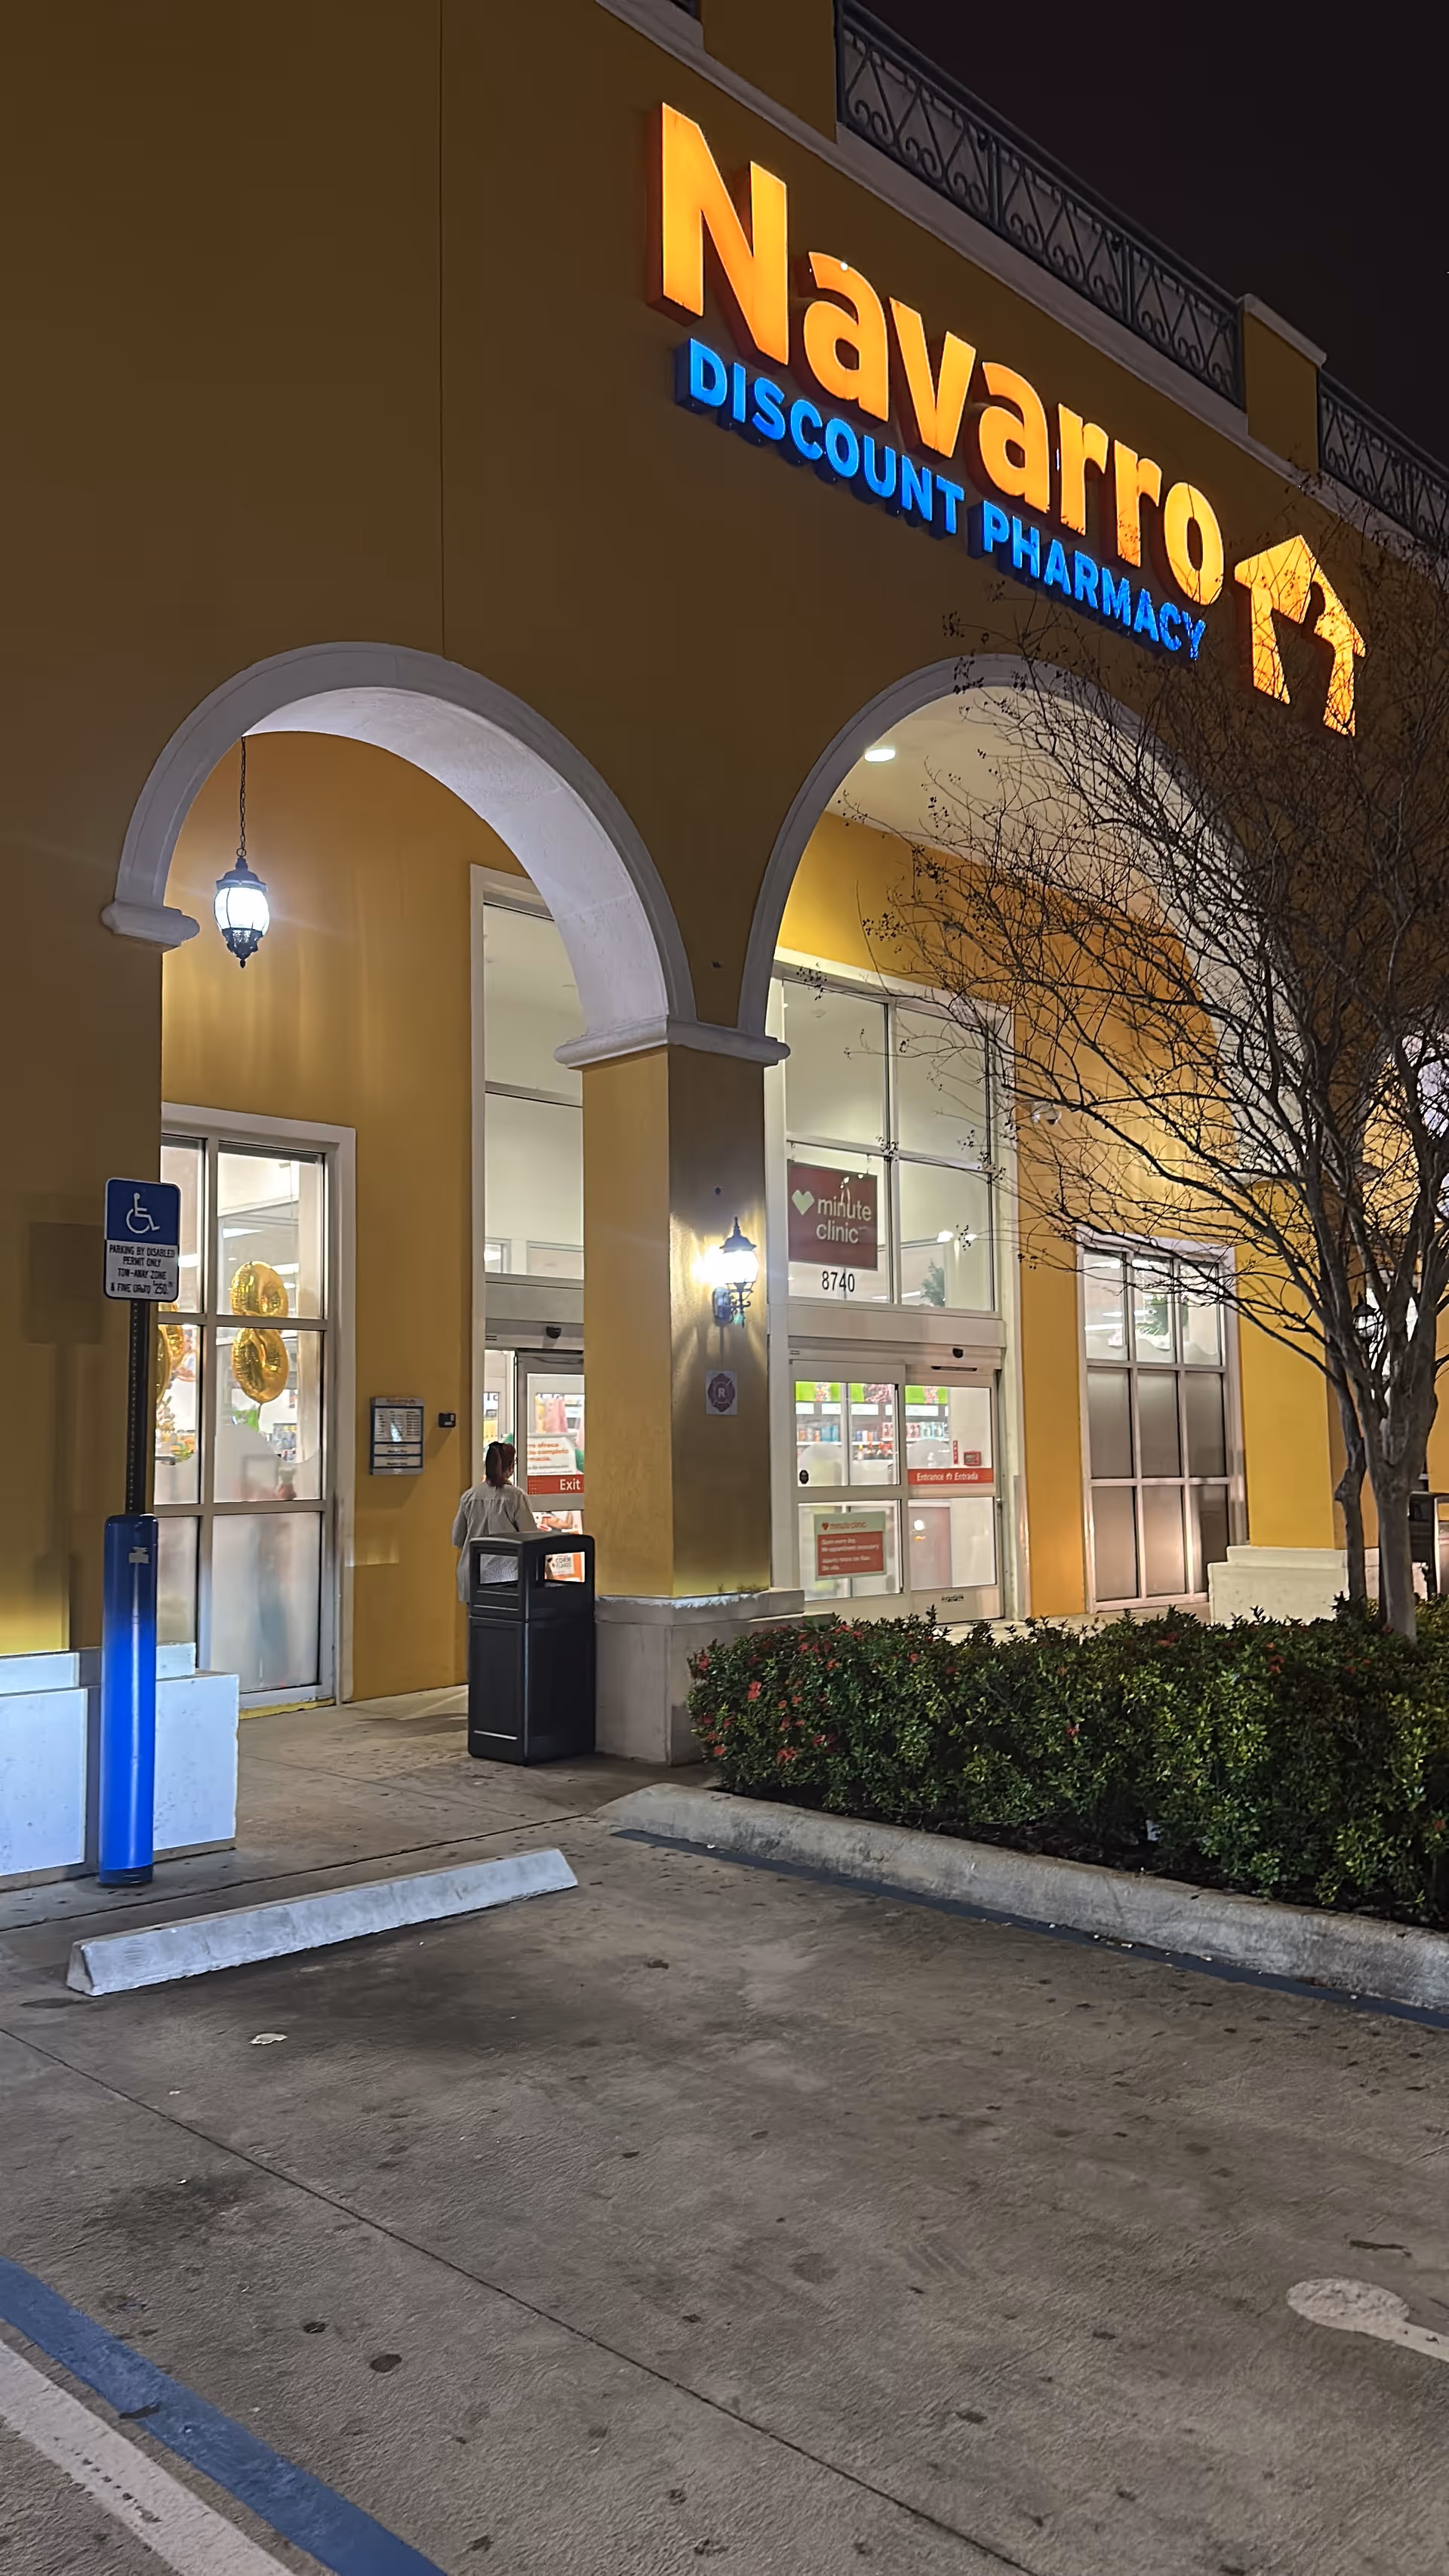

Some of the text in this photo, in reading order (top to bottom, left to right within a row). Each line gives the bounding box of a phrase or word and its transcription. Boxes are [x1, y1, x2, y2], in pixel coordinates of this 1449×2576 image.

[660, 100, 1224, 606] Navarro
[688, 337, 1208, 661] DISCOUNT PHARMACY
[817, 1196, 872, 1221] minute
[816, 1220, 859, 1244] clinic
[109, 1244, 175, 1257] PARKING BY DISABLED
[122, 1256, 162, 1266] PERMIT ONLY
[118, 1268, 167, 1279] TOW-AWAY ZONE
[118, 1283, 131, 1292] FINE
[821, 1270, 855, 1293] 8740
[718, 1387, 725, 1398] R
[916, 1471, 979, 1481] Entrance Entrada
[559, 1478, 581, 1491] Exit
